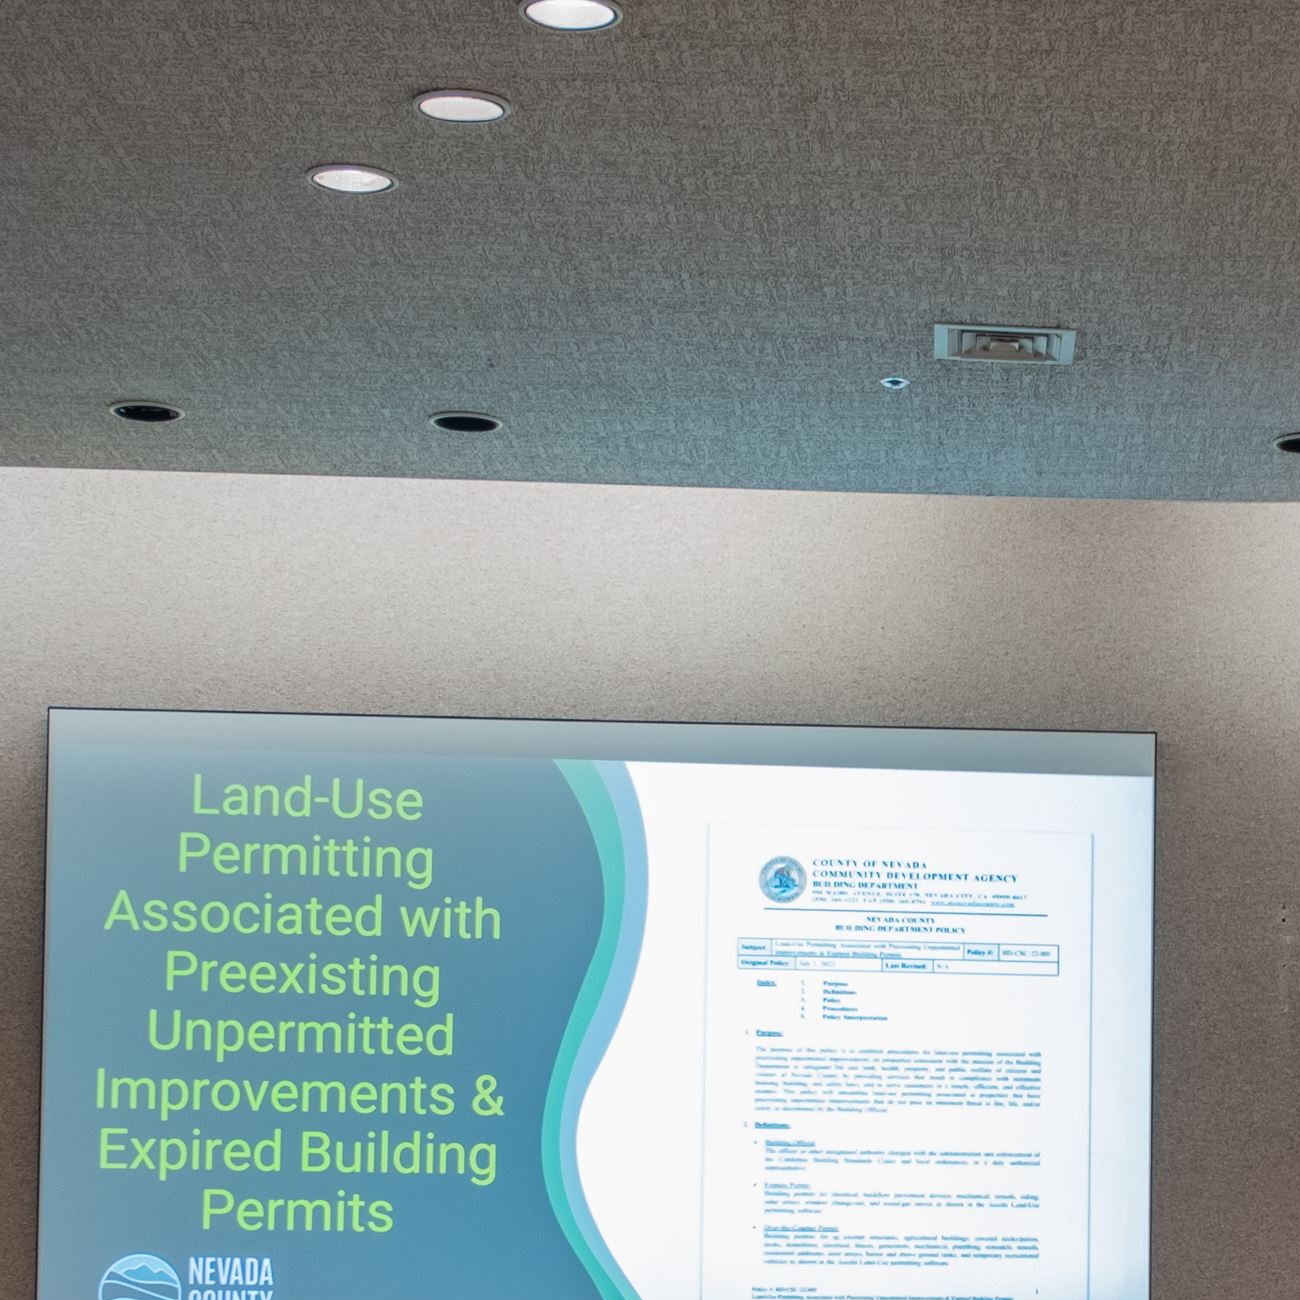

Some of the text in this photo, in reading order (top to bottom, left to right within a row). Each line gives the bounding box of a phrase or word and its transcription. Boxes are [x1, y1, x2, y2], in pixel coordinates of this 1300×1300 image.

[193, 775, 422, 820] Land-Use
[178, 832, 432, 890] Permitting
[882, 861, 927, 869] NEVADA
[887, 872, 969, 881] DEVELOPMENT
[974, 874, 1017, 883] AGENCY
[105, 890, 500, 939] Associated with
[166, 950, 440, 1008] Preexisting
[148, 1009, 454, 1062] Unpermitted
[96, 1068, 503, 1120] Improvements &
[100, 1127, 496, 1186] Expired Building
[202, 1188, 393, 1232] Permits
[188, 1256, 274, 1286] NEVADA
